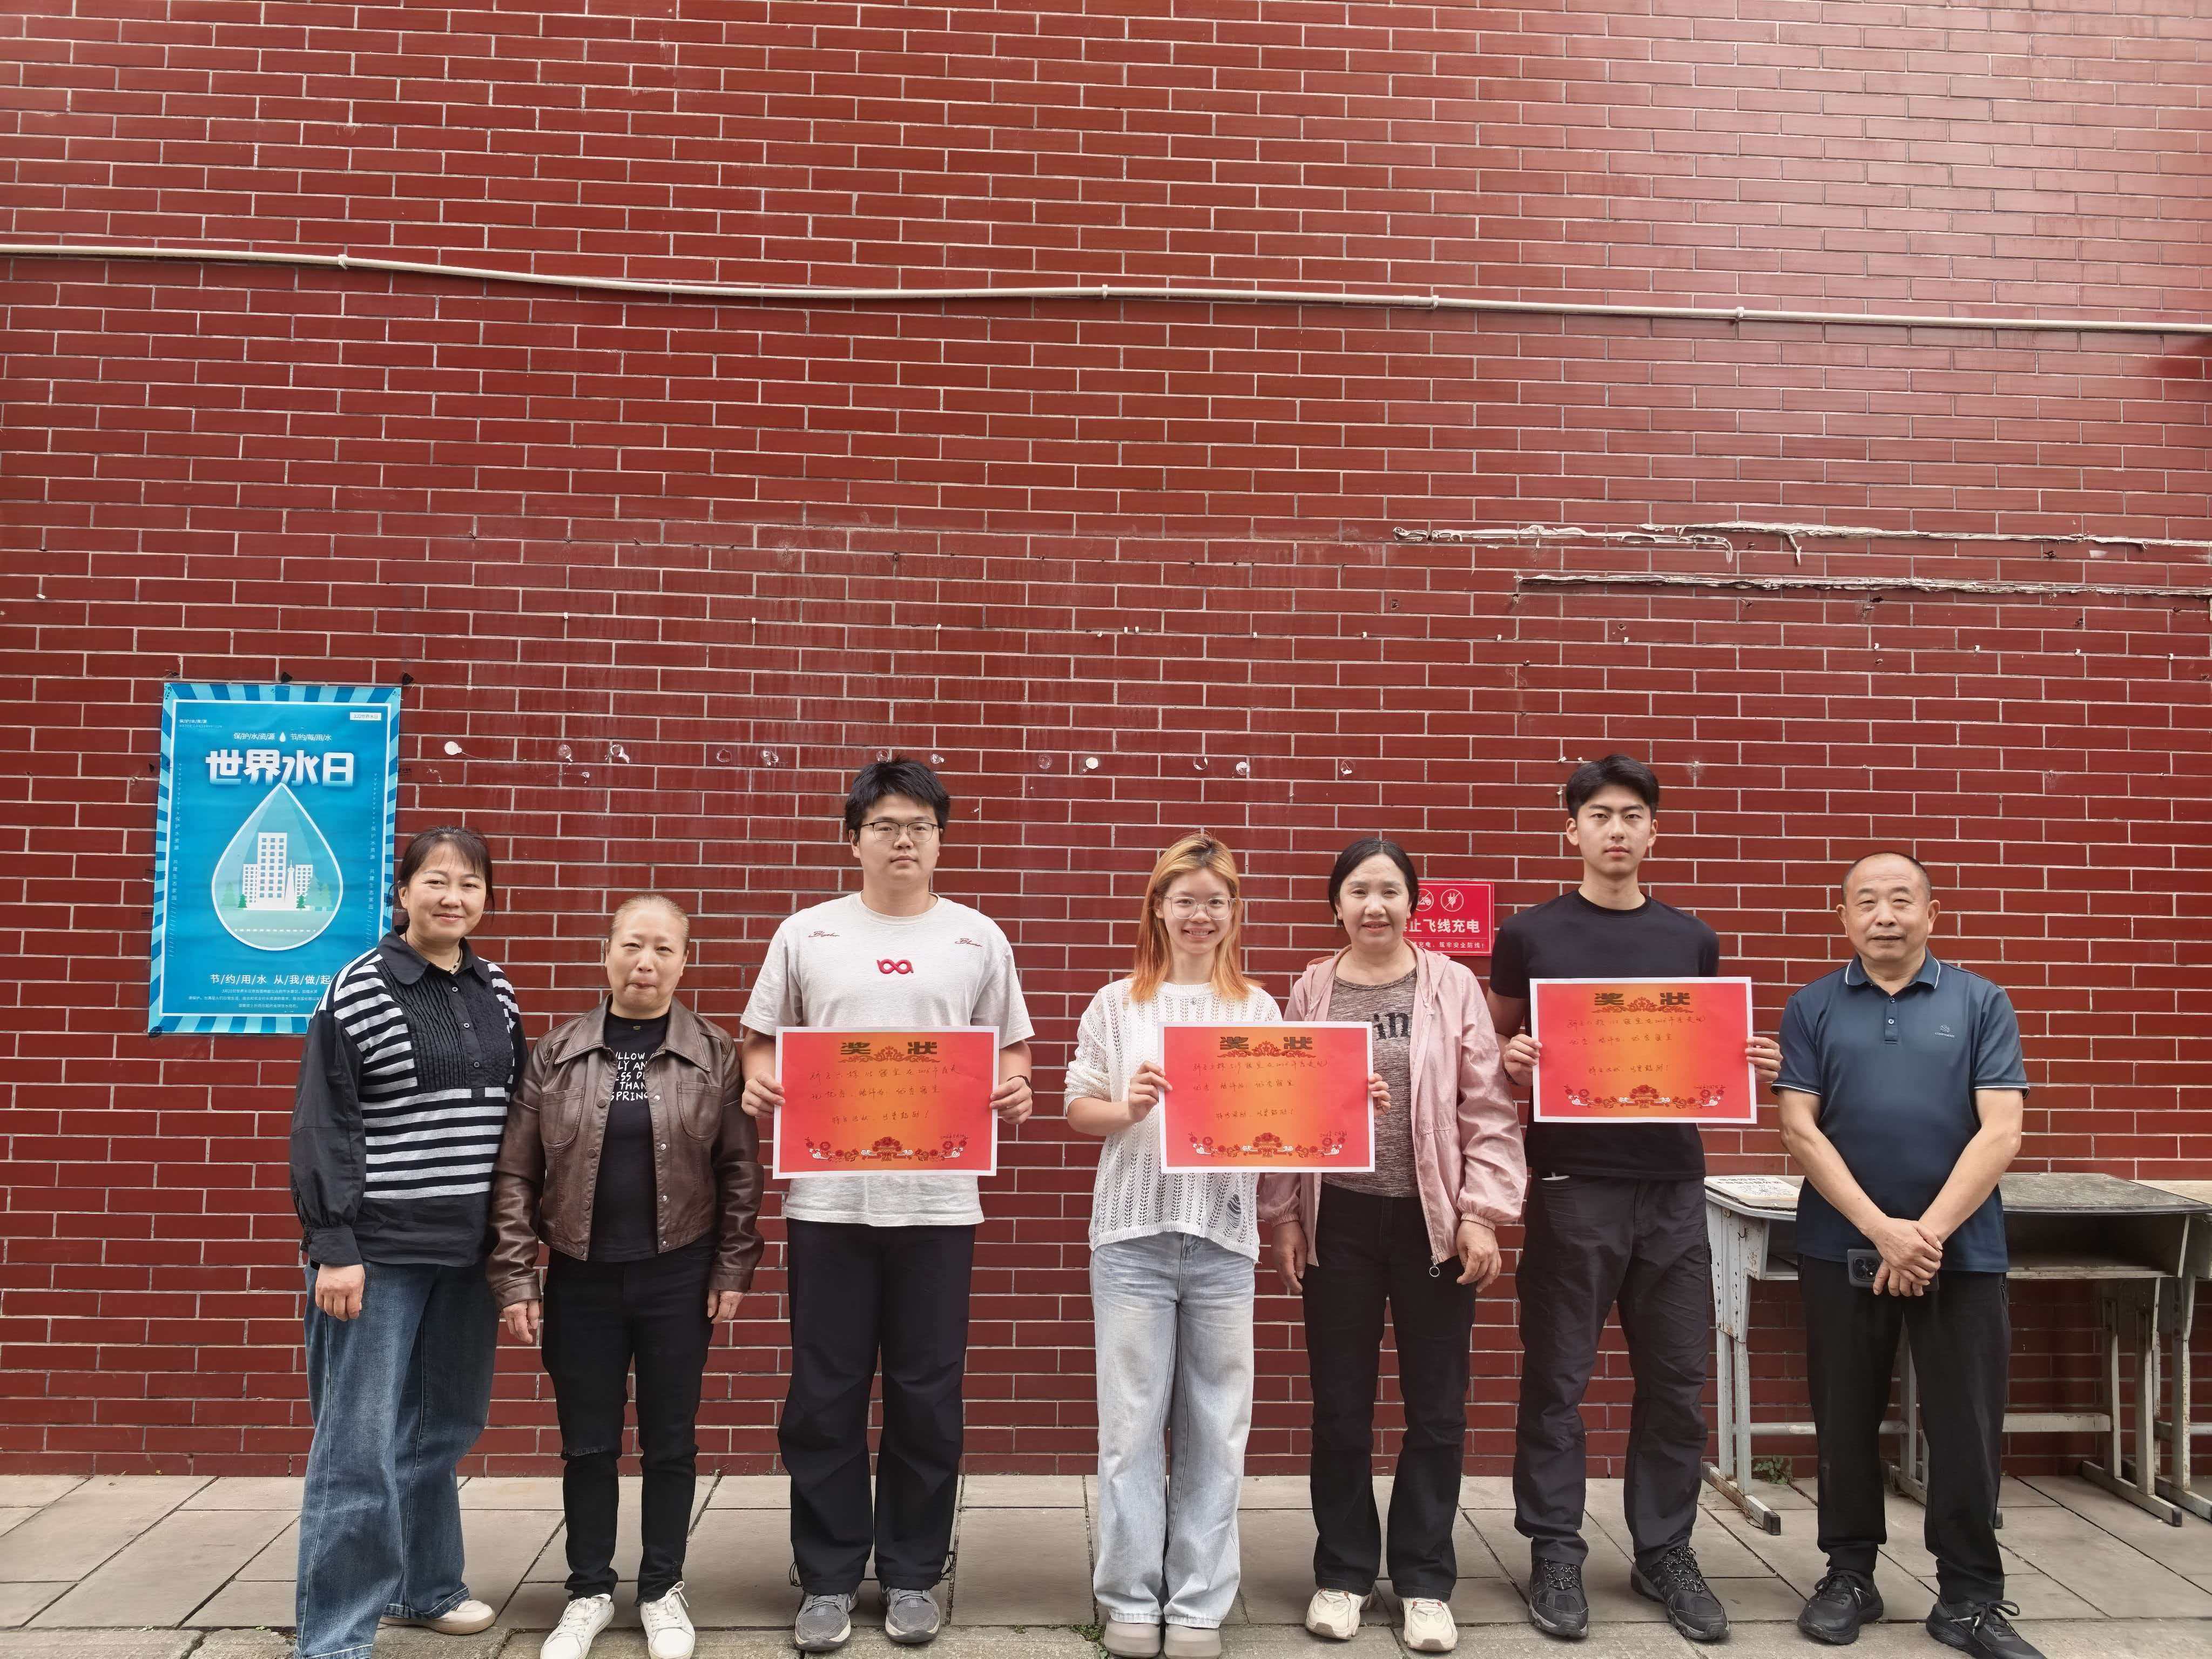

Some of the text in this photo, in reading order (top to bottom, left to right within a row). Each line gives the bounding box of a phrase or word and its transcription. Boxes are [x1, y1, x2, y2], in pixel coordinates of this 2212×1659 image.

[205, 749, 354, 787] 世界水日
[1404, 918, 1480, 933] 止飞线充电
[210, 974, 332, 986] 节/约/用/水 从/我/做/起
[1594, 993, 1690, 1006] 奖状
[840, 1041, 938, 1055] 奖状
[1219, 1036, 1313, 1050] 奖状
